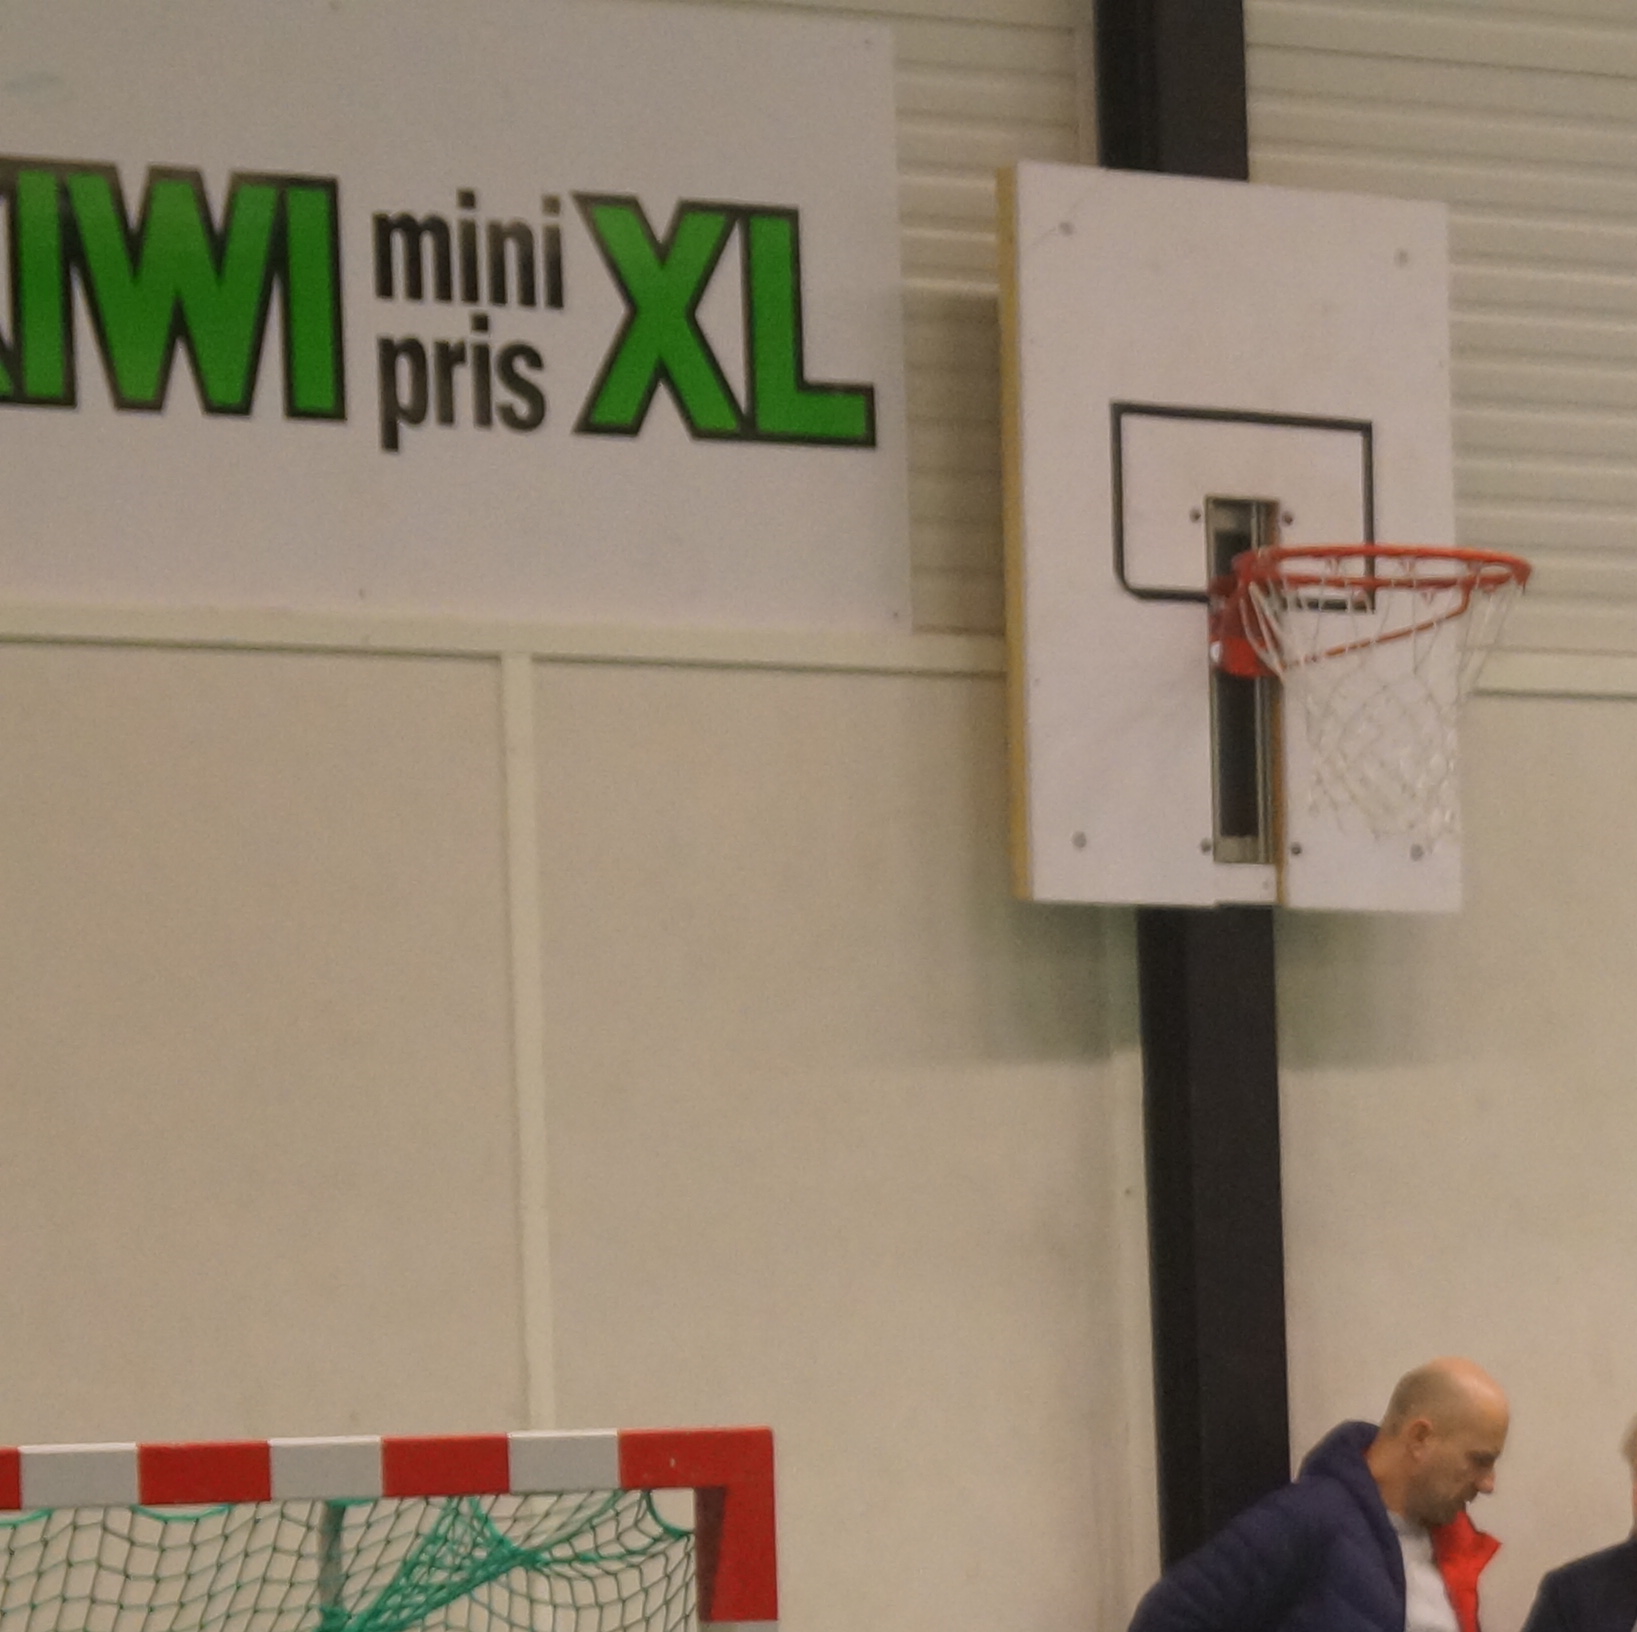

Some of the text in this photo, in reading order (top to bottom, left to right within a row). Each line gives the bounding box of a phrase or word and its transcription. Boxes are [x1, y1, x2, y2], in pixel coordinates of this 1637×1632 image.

[0, 156, 347, 421] IWI
[372, 188, 565, 311] mini
[570, 189, 877, 449] XL
[376, 313, 547, 452] pris
